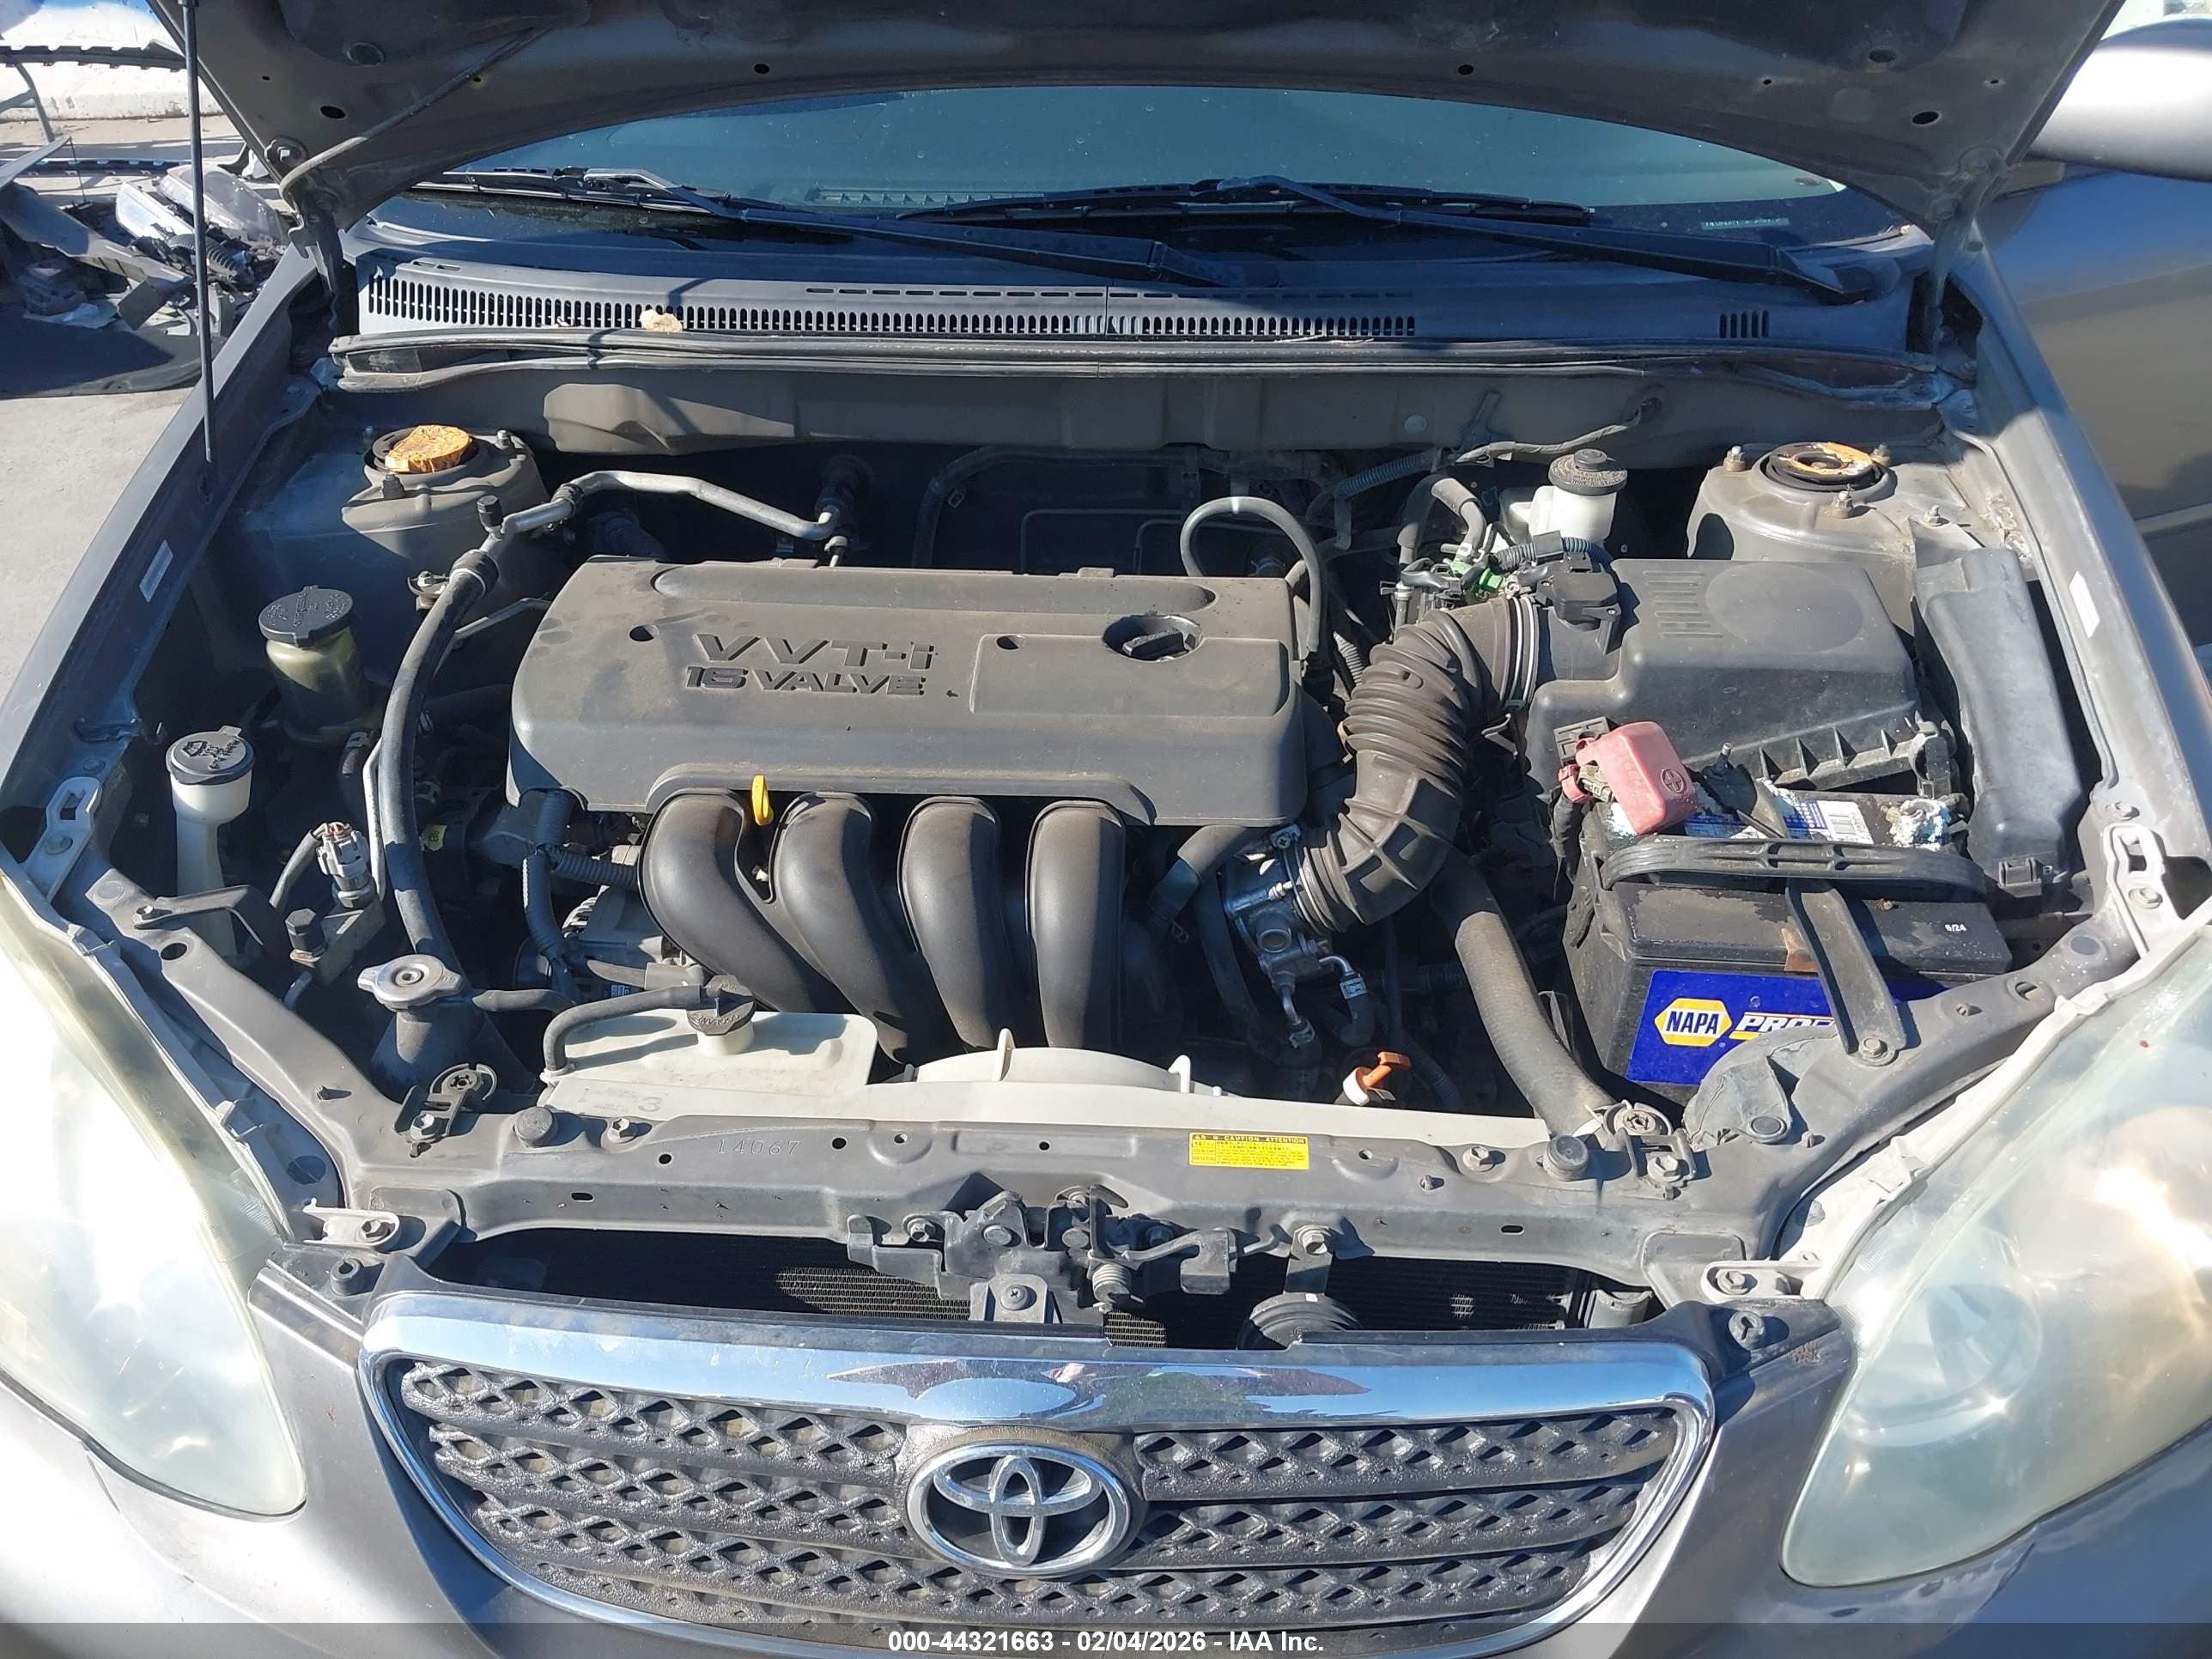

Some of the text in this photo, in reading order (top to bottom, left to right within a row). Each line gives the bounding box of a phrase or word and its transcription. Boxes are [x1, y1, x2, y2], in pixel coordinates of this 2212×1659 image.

[686, 666, 927, 696] 16 VALVE
[1665, 1011, 1720, 1035] NAPA
[717, 1139, 801, 1155] 14067
